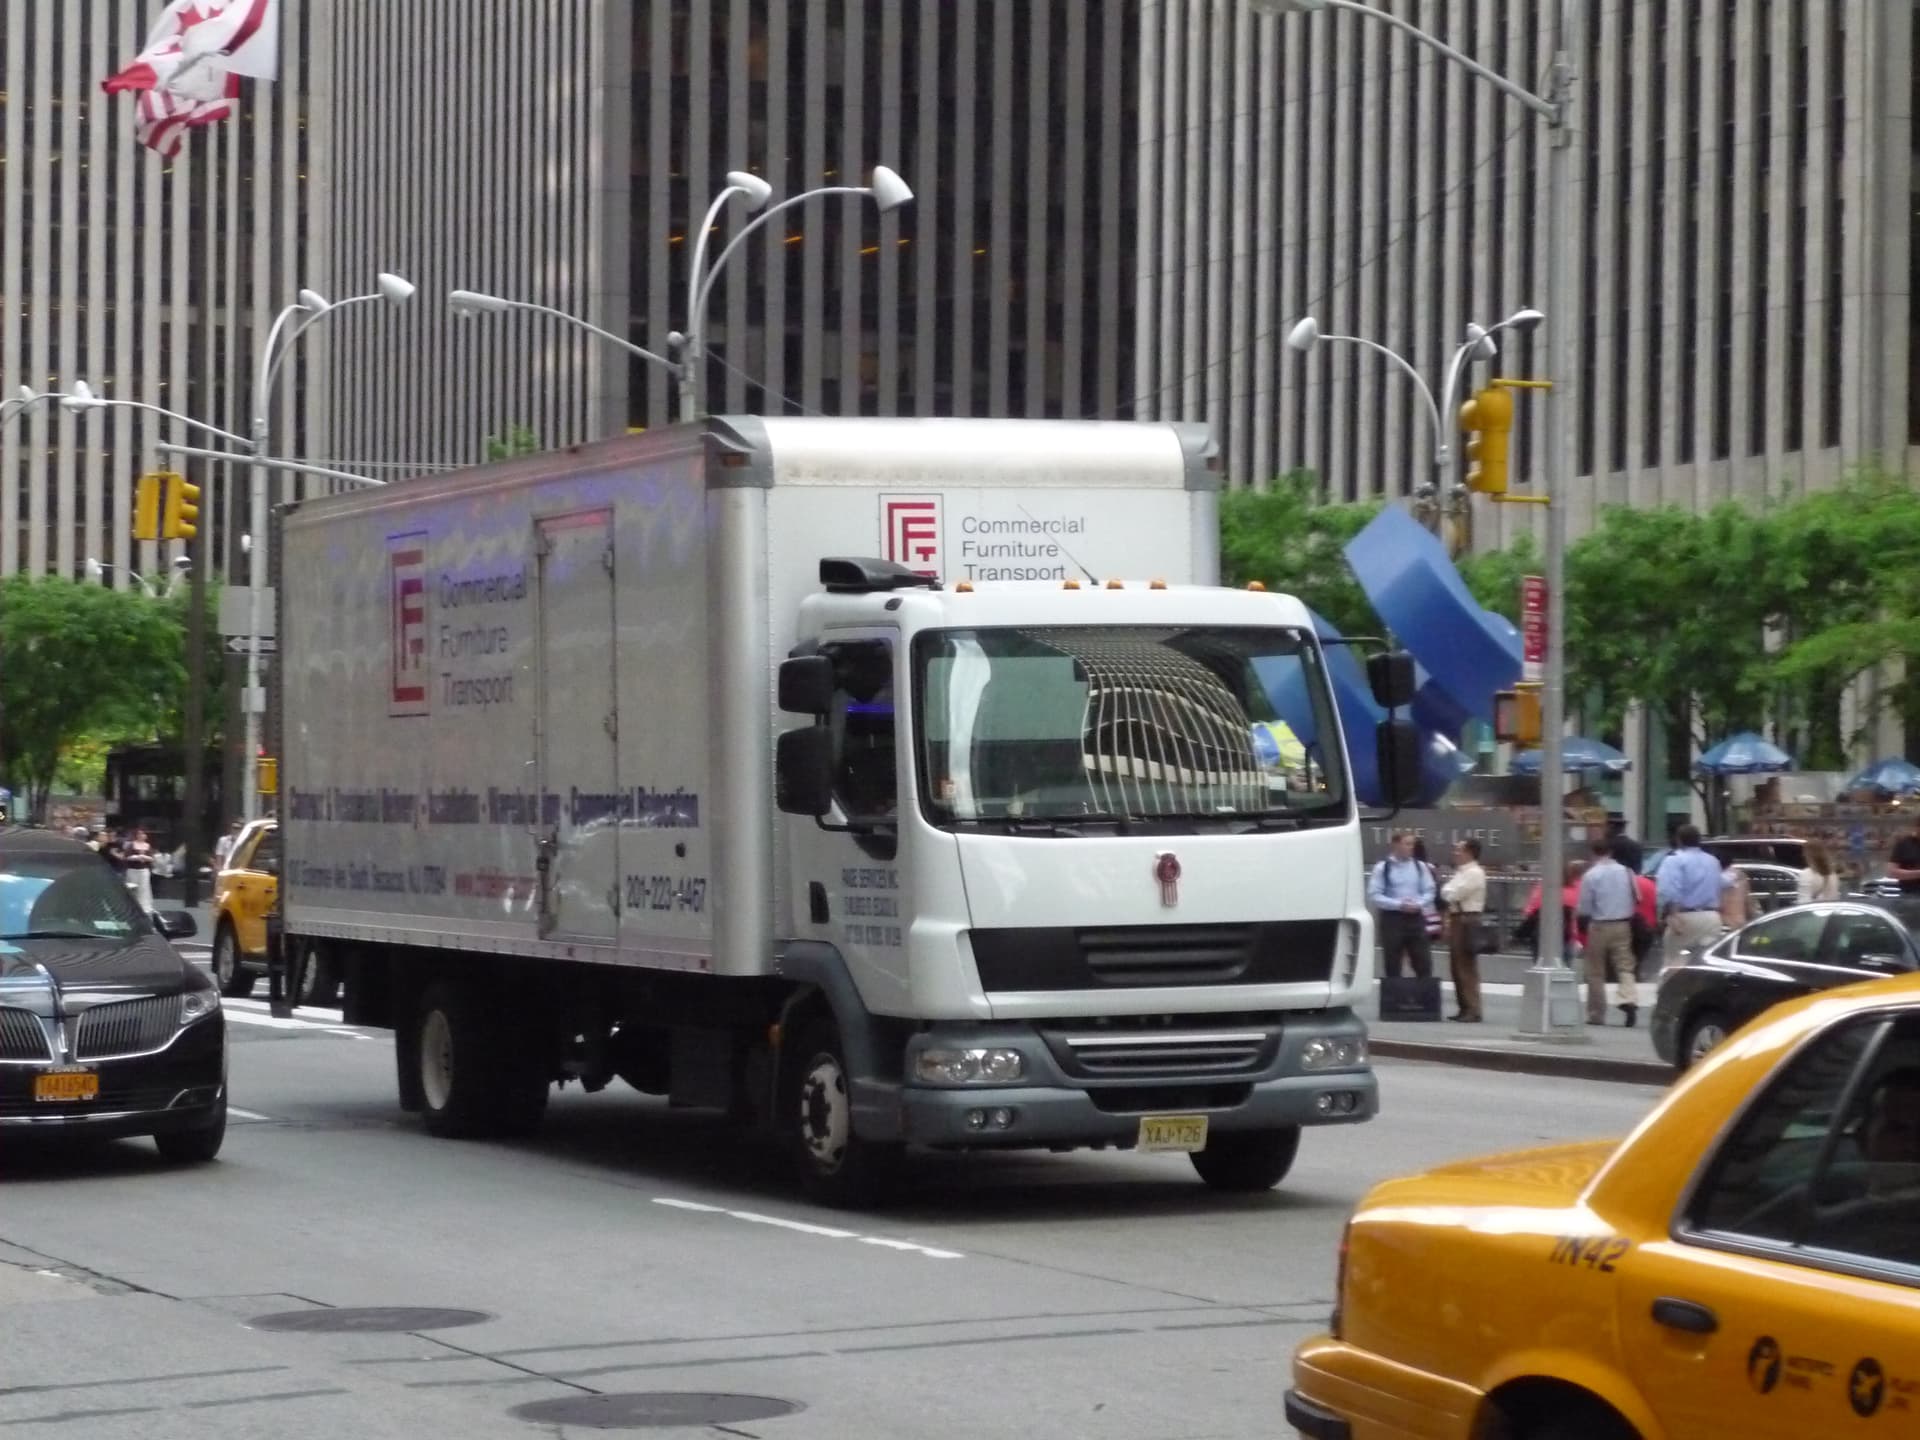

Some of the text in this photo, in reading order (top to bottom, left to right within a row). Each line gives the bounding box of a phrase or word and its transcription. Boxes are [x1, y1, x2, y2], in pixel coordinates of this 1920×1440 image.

[961, 516, 1085, 534] Commercial
[962, 541, 1059, 557] Furniture
[963, 564, 1066, 581] Transport
[441, 564, 527, 608] Commercial
[441, 623, 507, 657] Furniture
[441, 672, 513, 711] Transport
